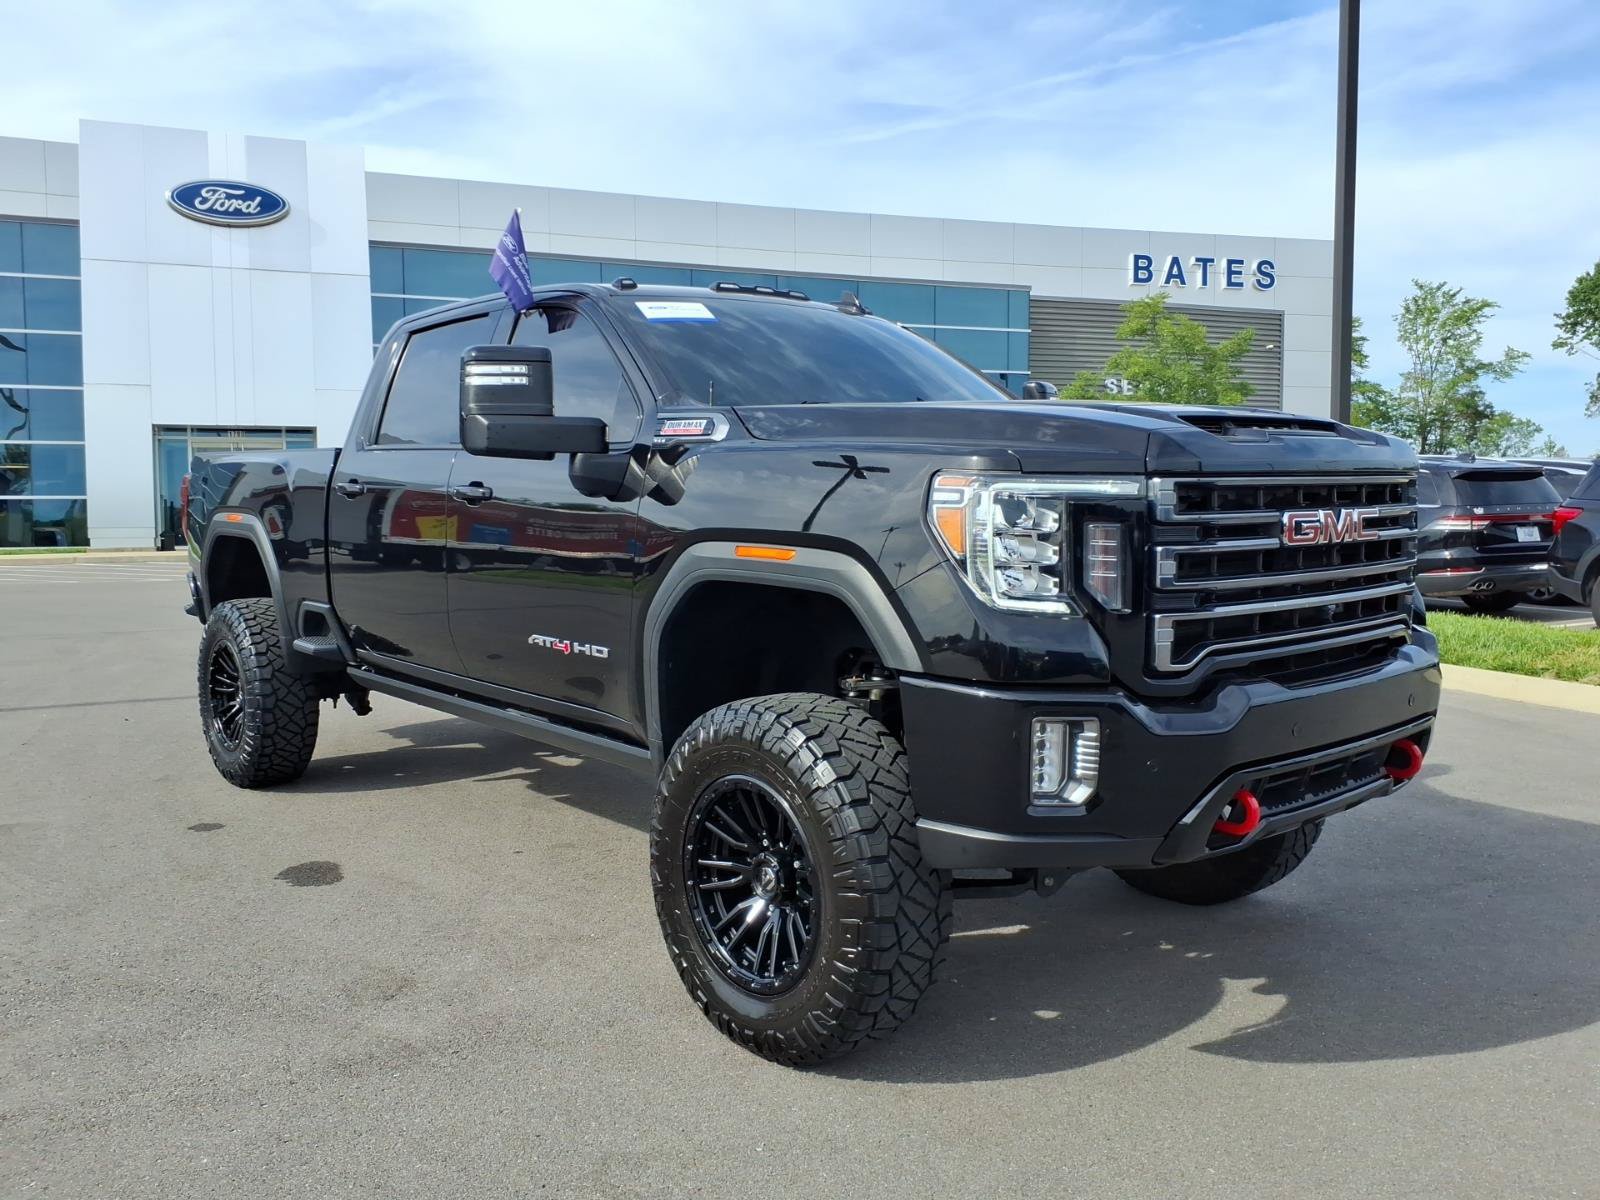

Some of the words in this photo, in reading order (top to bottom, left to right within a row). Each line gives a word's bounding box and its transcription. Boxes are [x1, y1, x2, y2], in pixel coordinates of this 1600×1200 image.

[194, 186, 262, 214] Ford
[1129, 253, 1277, 290] BATES
[667, 420, 704, 429] DURAMAX
[1283, 507, 1380, 546] GMC
[528, 634, 571, 655] AT4
[573, 642, 609, 658] HD
